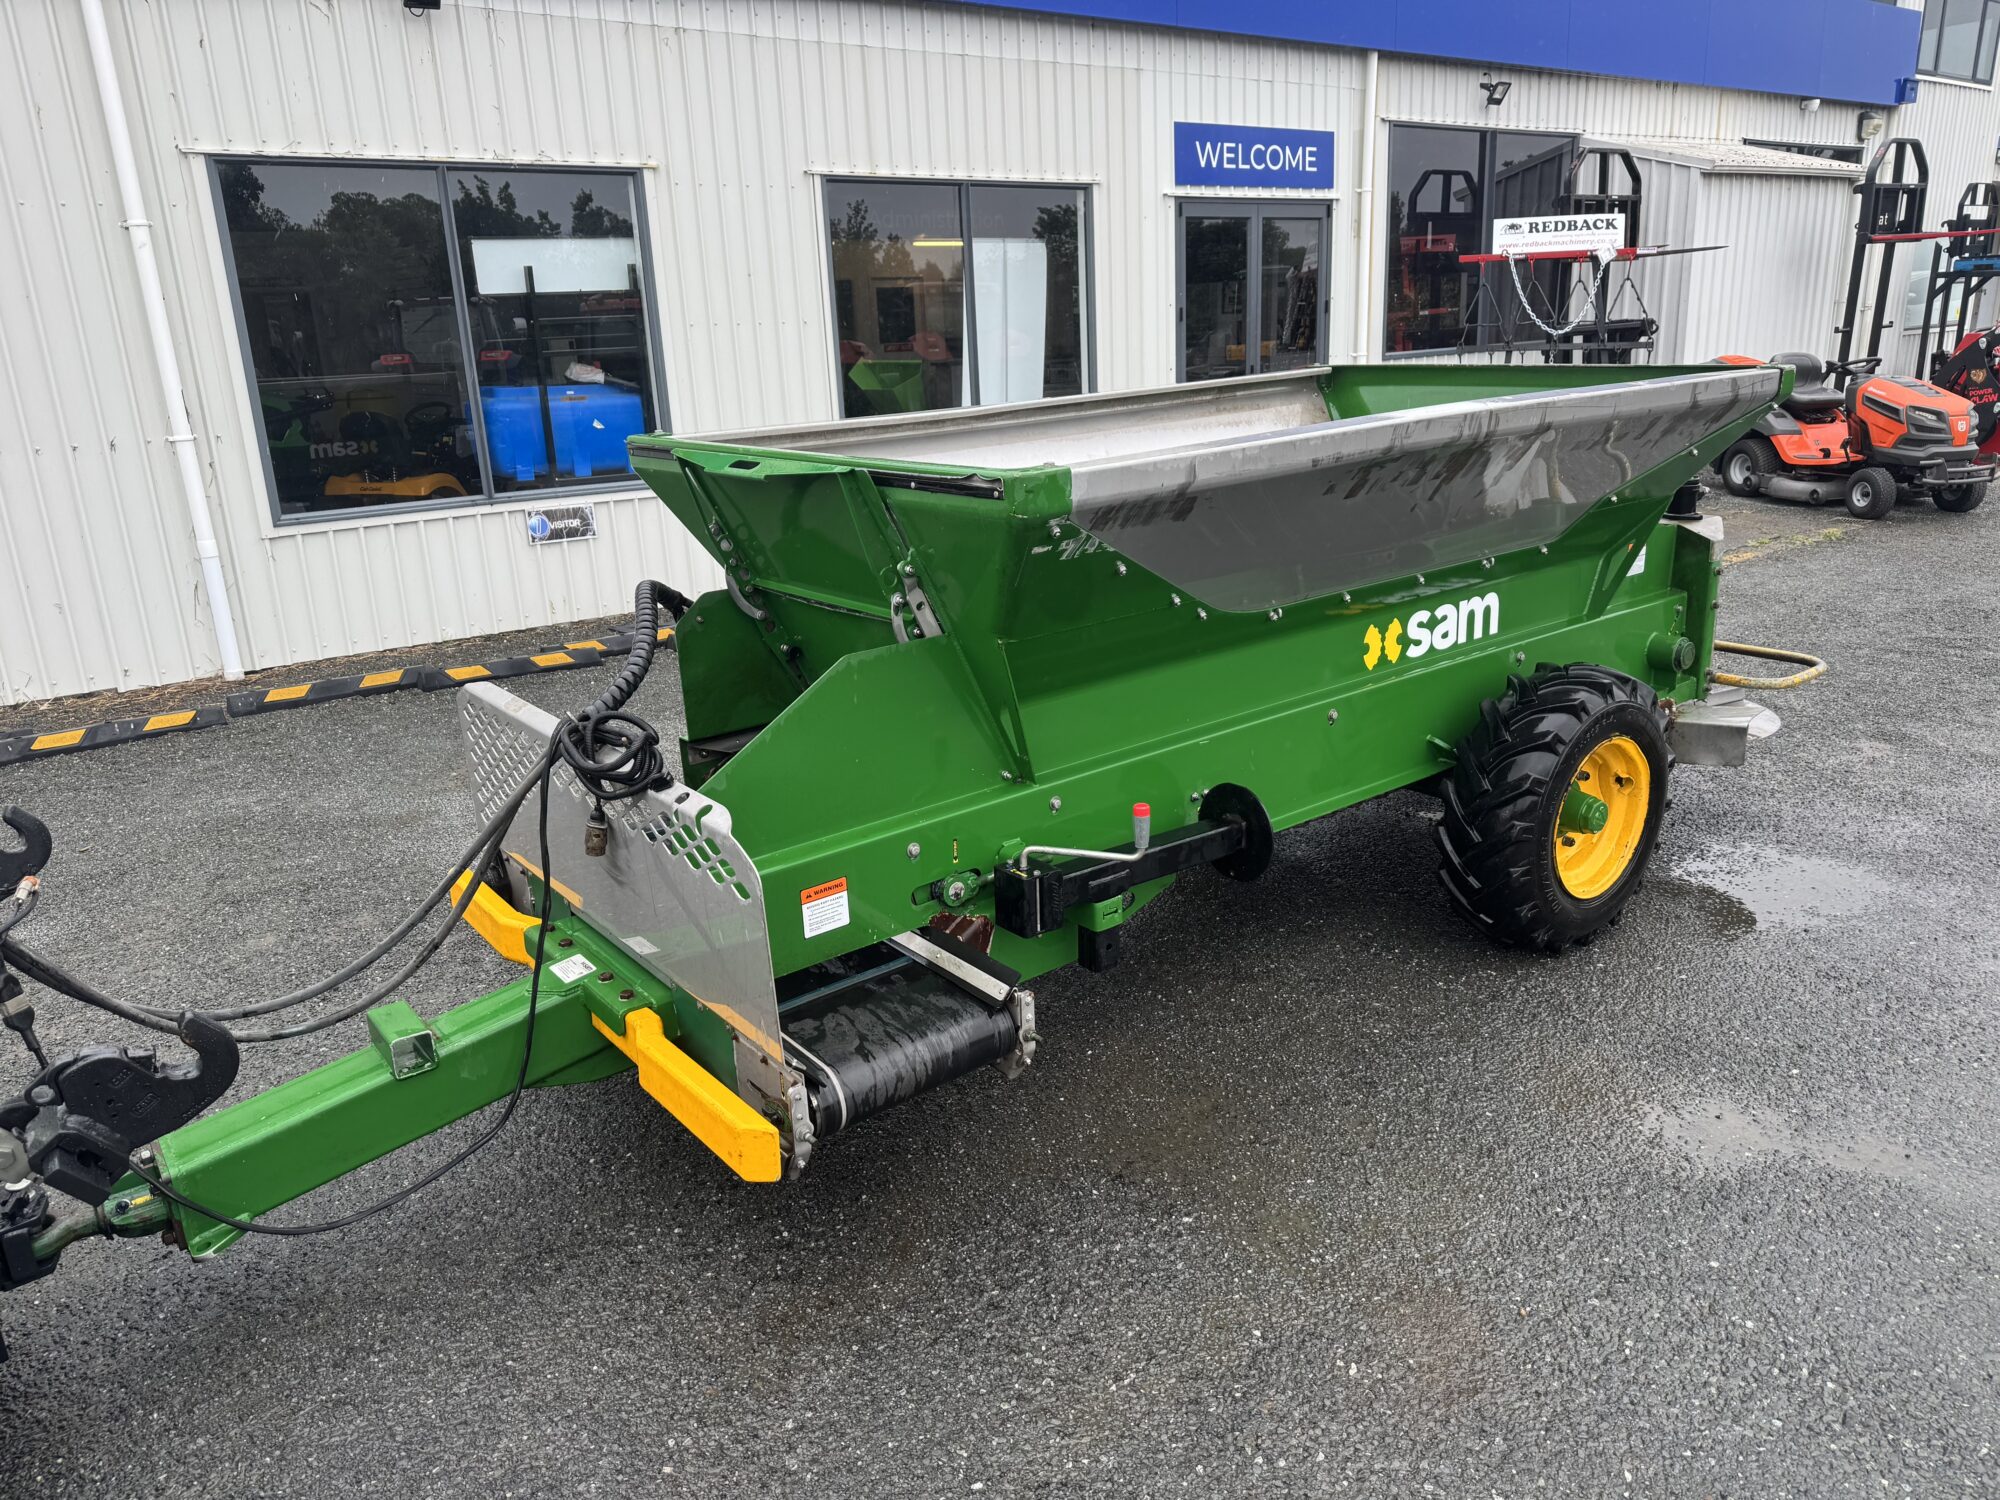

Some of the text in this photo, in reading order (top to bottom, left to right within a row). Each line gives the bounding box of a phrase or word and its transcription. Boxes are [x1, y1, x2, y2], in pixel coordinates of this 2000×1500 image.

[1195, 140, 1318, 172] WELCOME
[1528, 217, 1619, 234] REDBACK
[1498, 238, 1618, 249] www.redbackmachinery.conz
[1969, 387, 1993, 397] POWER
[549, 519, 581, 529] VISITOR
[1406, 592, 1500, 658] sam
[814, 881, 844, 895] WARNING
